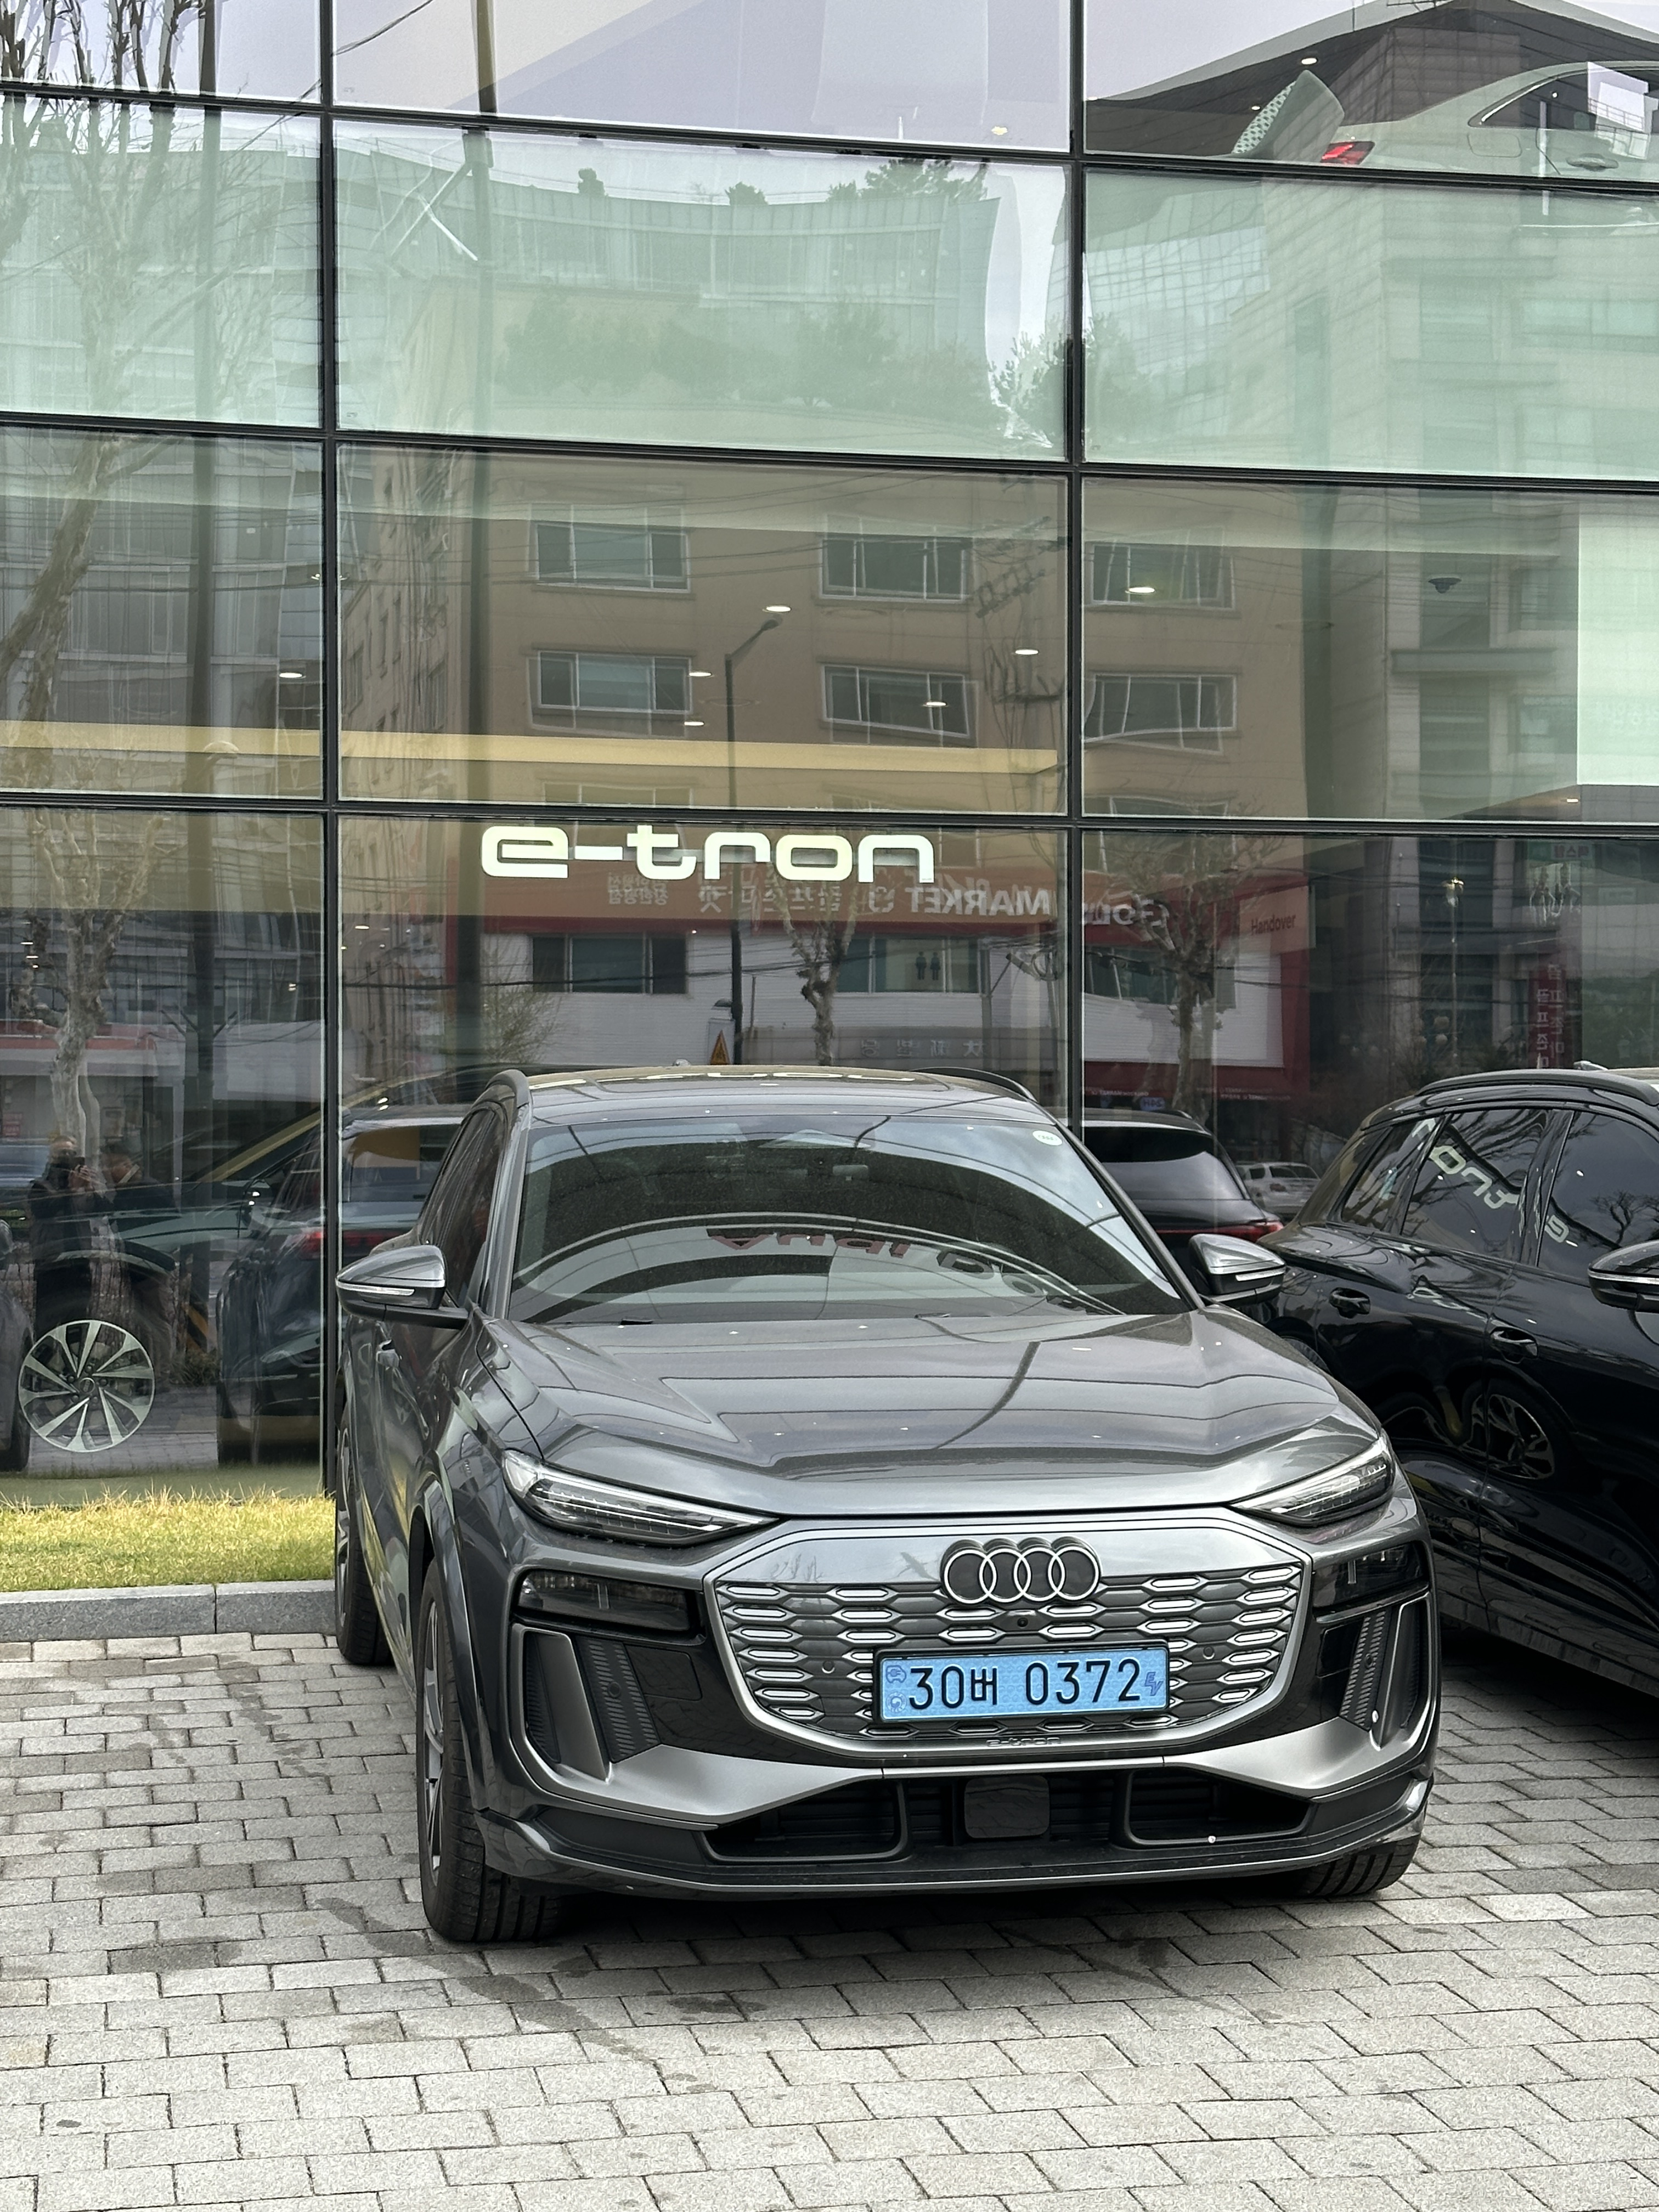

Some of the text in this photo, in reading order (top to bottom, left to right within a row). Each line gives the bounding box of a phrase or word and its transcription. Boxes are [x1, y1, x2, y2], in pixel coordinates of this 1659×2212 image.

[481, 824, 935, 884] e-tron
[1250, 913, 1296, 935] Handover
[909, 1664, 998, 1711] 30버
[1025, 1658, 1141, 1706] 0372
[1144, 1671, 1164, 1697] EV
[986, 1736, 1061, 1747] e-tron
